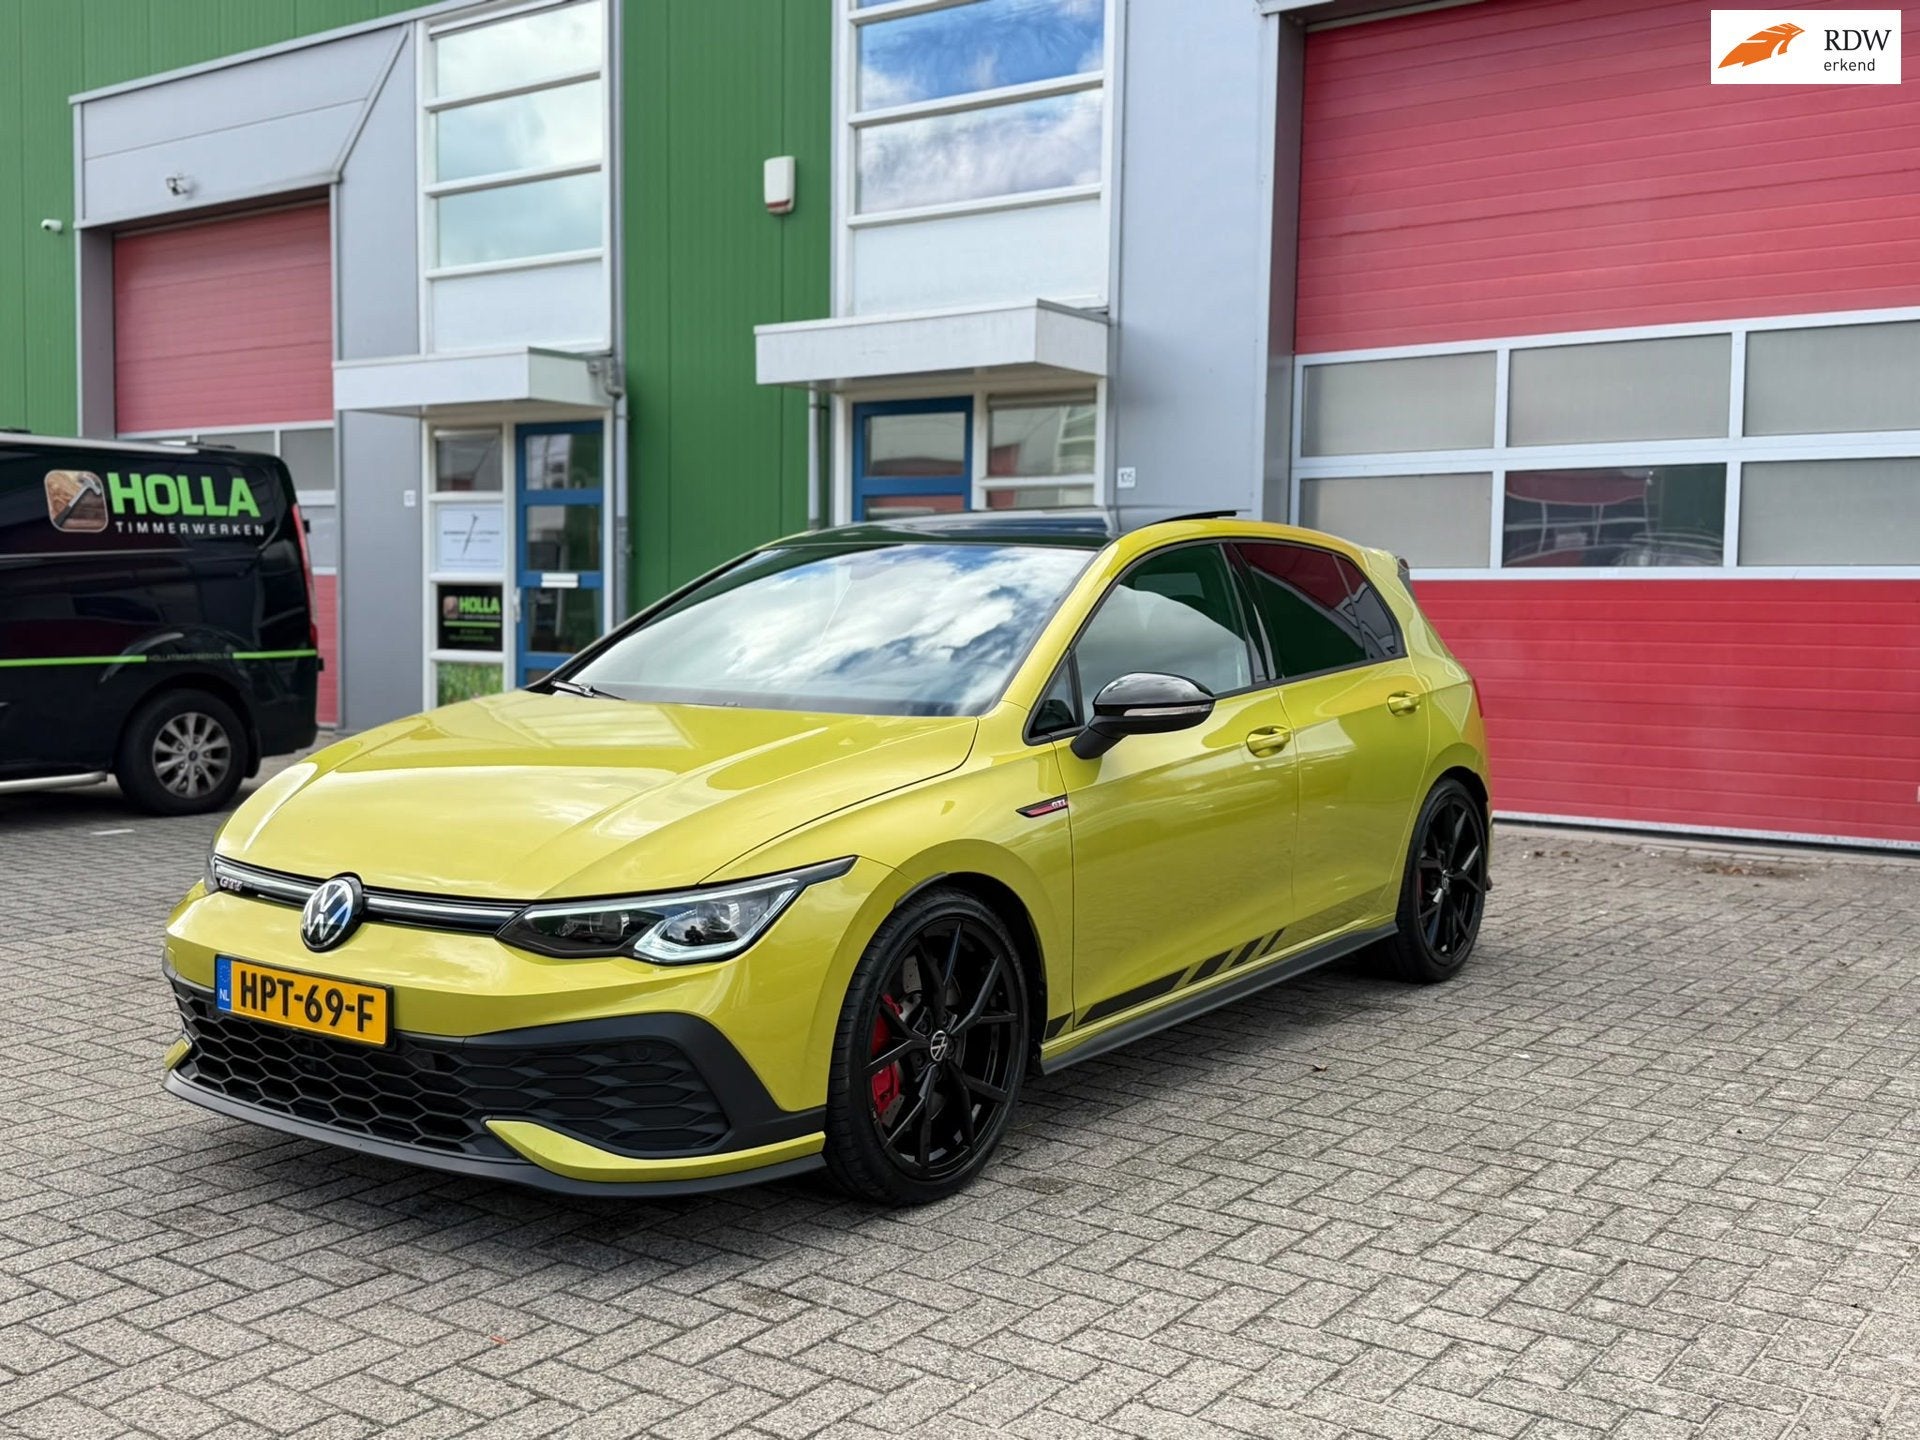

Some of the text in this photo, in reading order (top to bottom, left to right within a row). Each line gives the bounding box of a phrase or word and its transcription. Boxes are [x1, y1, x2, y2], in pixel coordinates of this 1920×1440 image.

[107, 472, 261, 517] HOLLA
[115, 521, 265, 536] TIMMERWERKEN
[459, 596, 501, 614] HOLLA
[1051, 799, 1066, 809] GTI
[219, 876, 243, 892] GTI
[219, 970, 375, 1033] NL HPT-69-F
